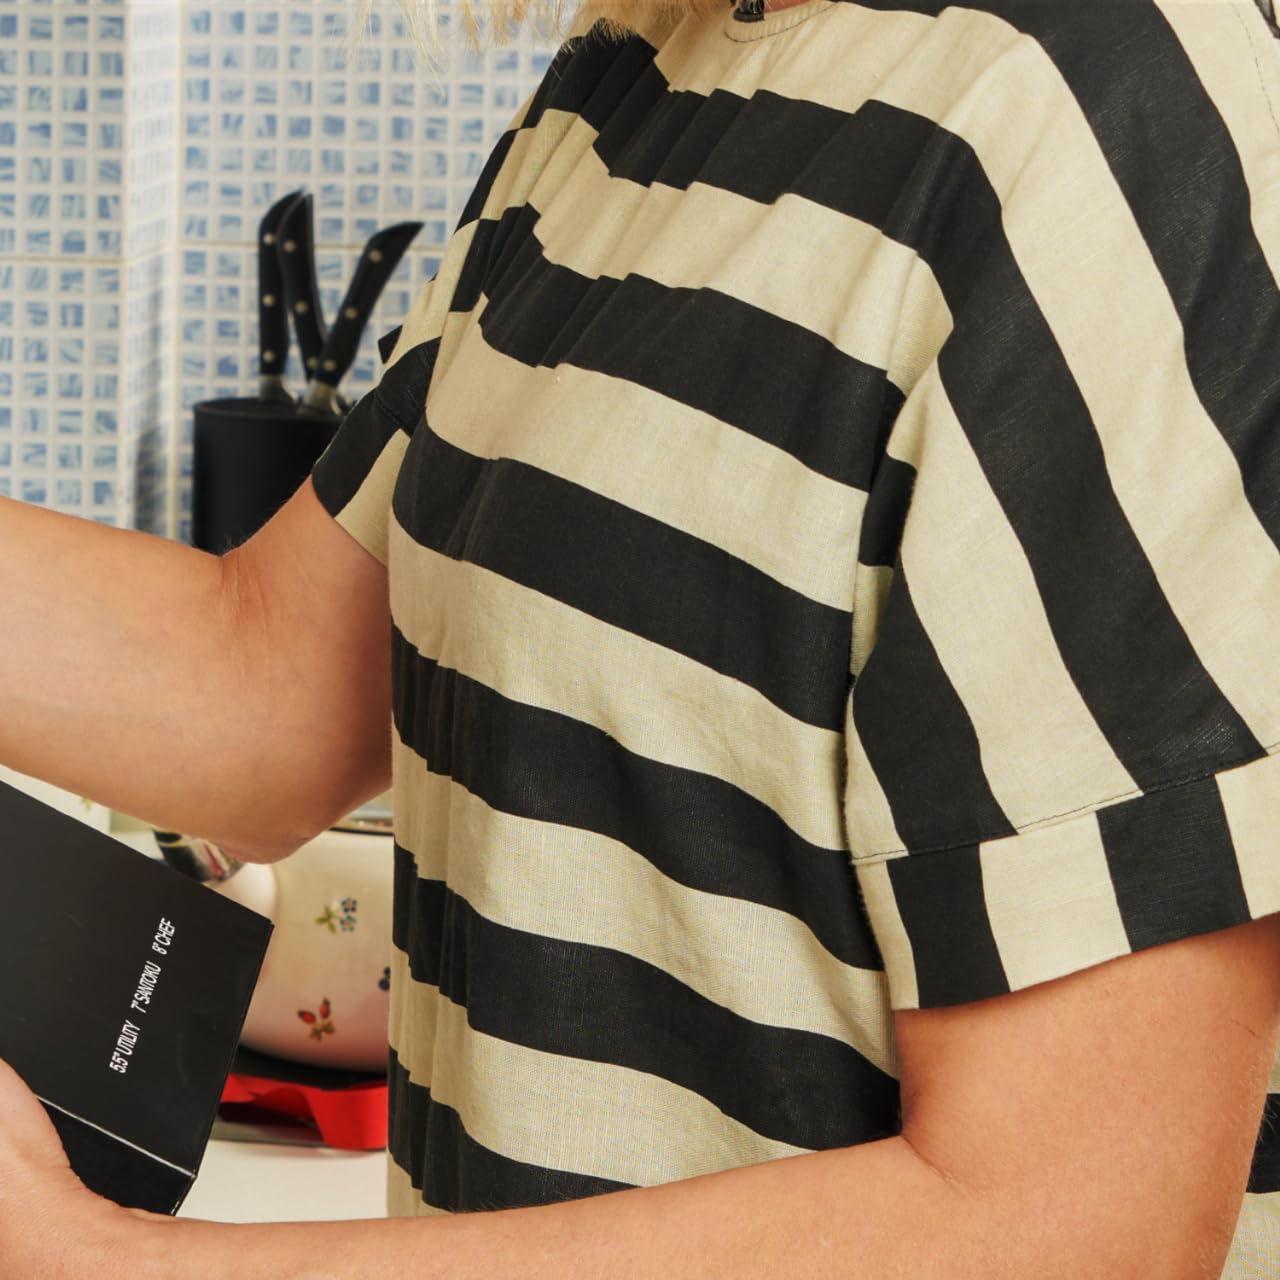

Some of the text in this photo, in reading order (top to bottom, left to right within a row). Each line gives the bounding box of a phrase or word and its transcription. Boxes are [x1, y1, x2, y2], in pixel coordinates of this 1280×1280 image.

[115, 1019, 140, 1055] UTILITY
[134, 960, 161, 1005] SANTOKU
[154, 917, 175, 946] CHEF
